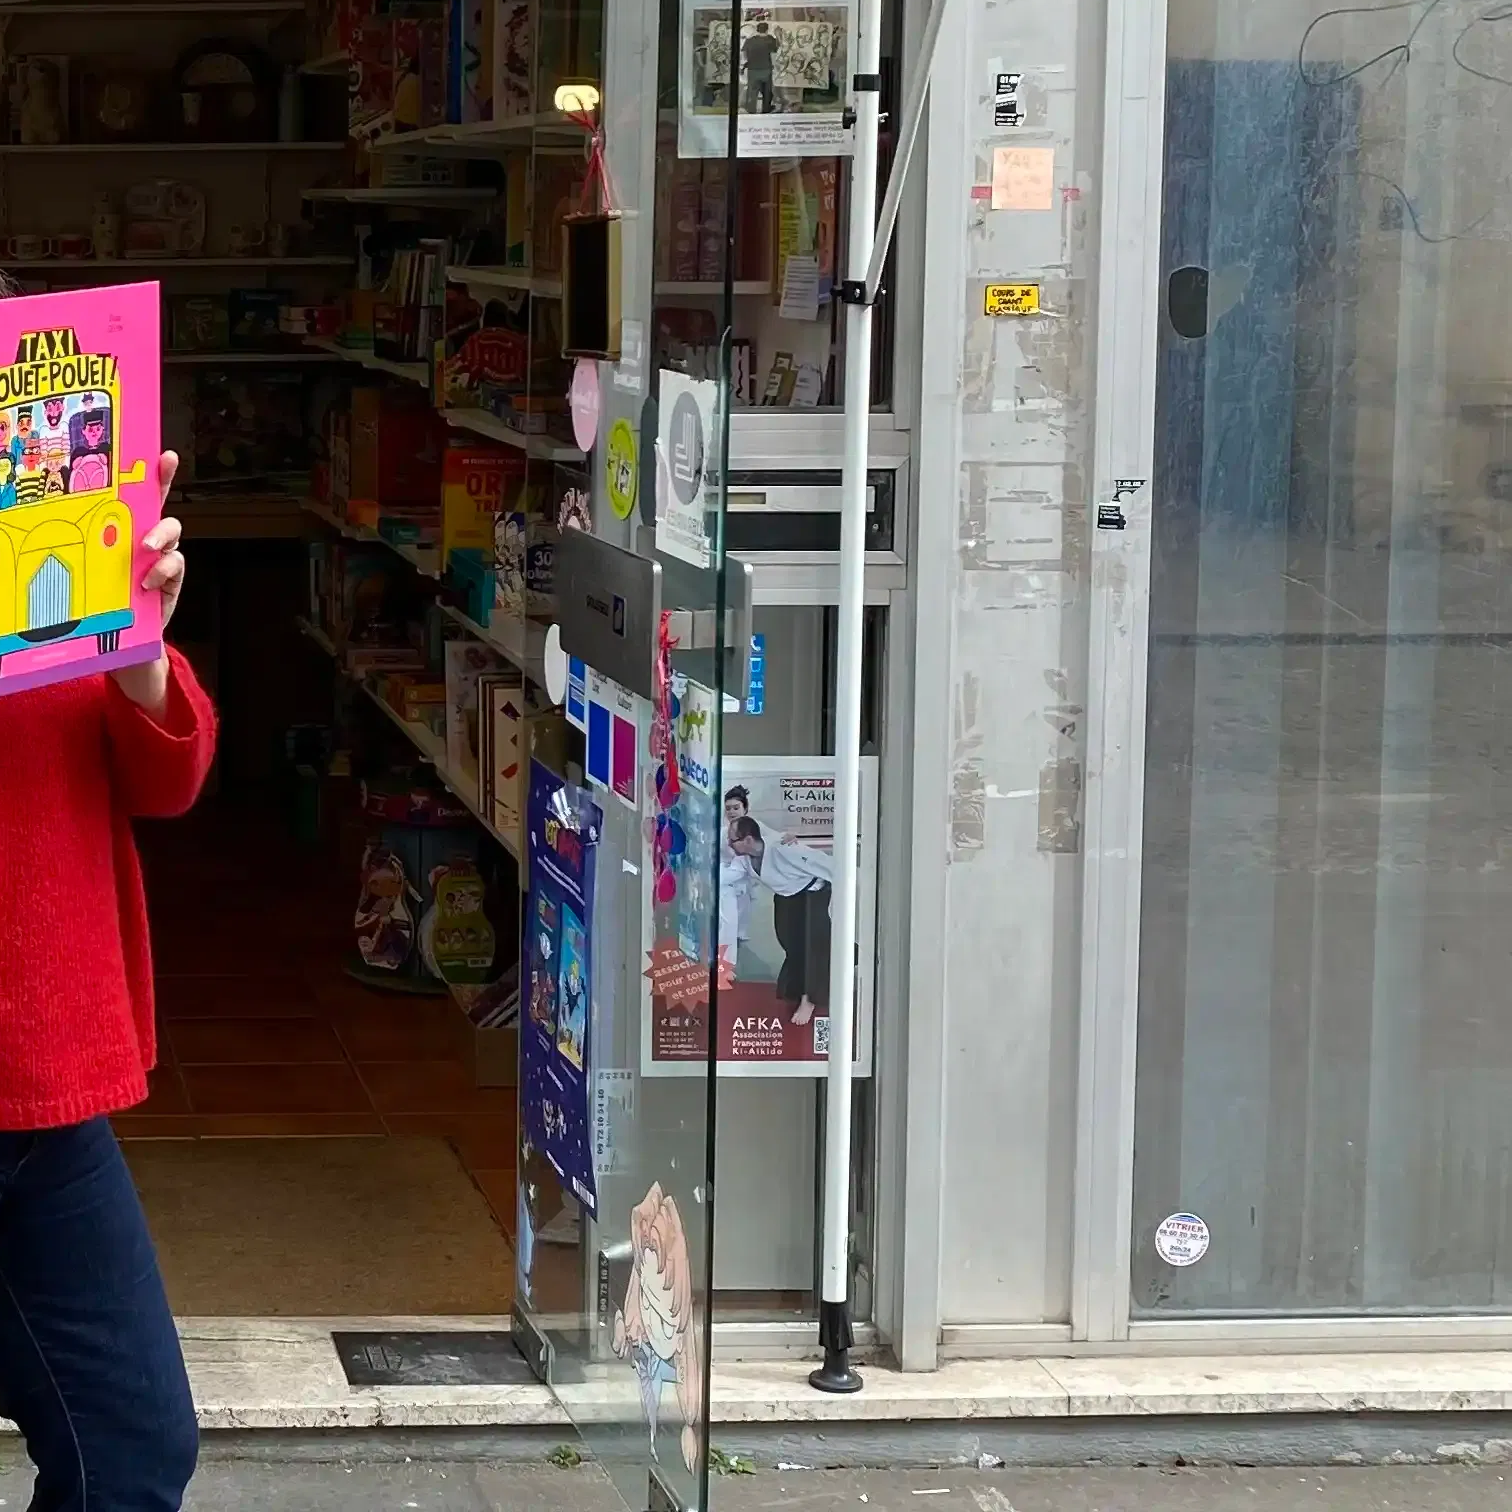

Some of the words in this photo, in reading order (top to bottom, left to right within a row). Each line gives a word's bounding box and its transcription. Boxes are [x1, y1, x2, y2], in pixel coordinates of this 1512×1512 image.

[22, 328, 75, 363] TAXI
[658, 975, 684, 993] pour
[732, 1017, 783, 1030] AFKA
[732, 1030, 783, 1039] Association
[772, 1039, 783, 1047] de
[1166, 1221, 1204, 1234] VITRIER
